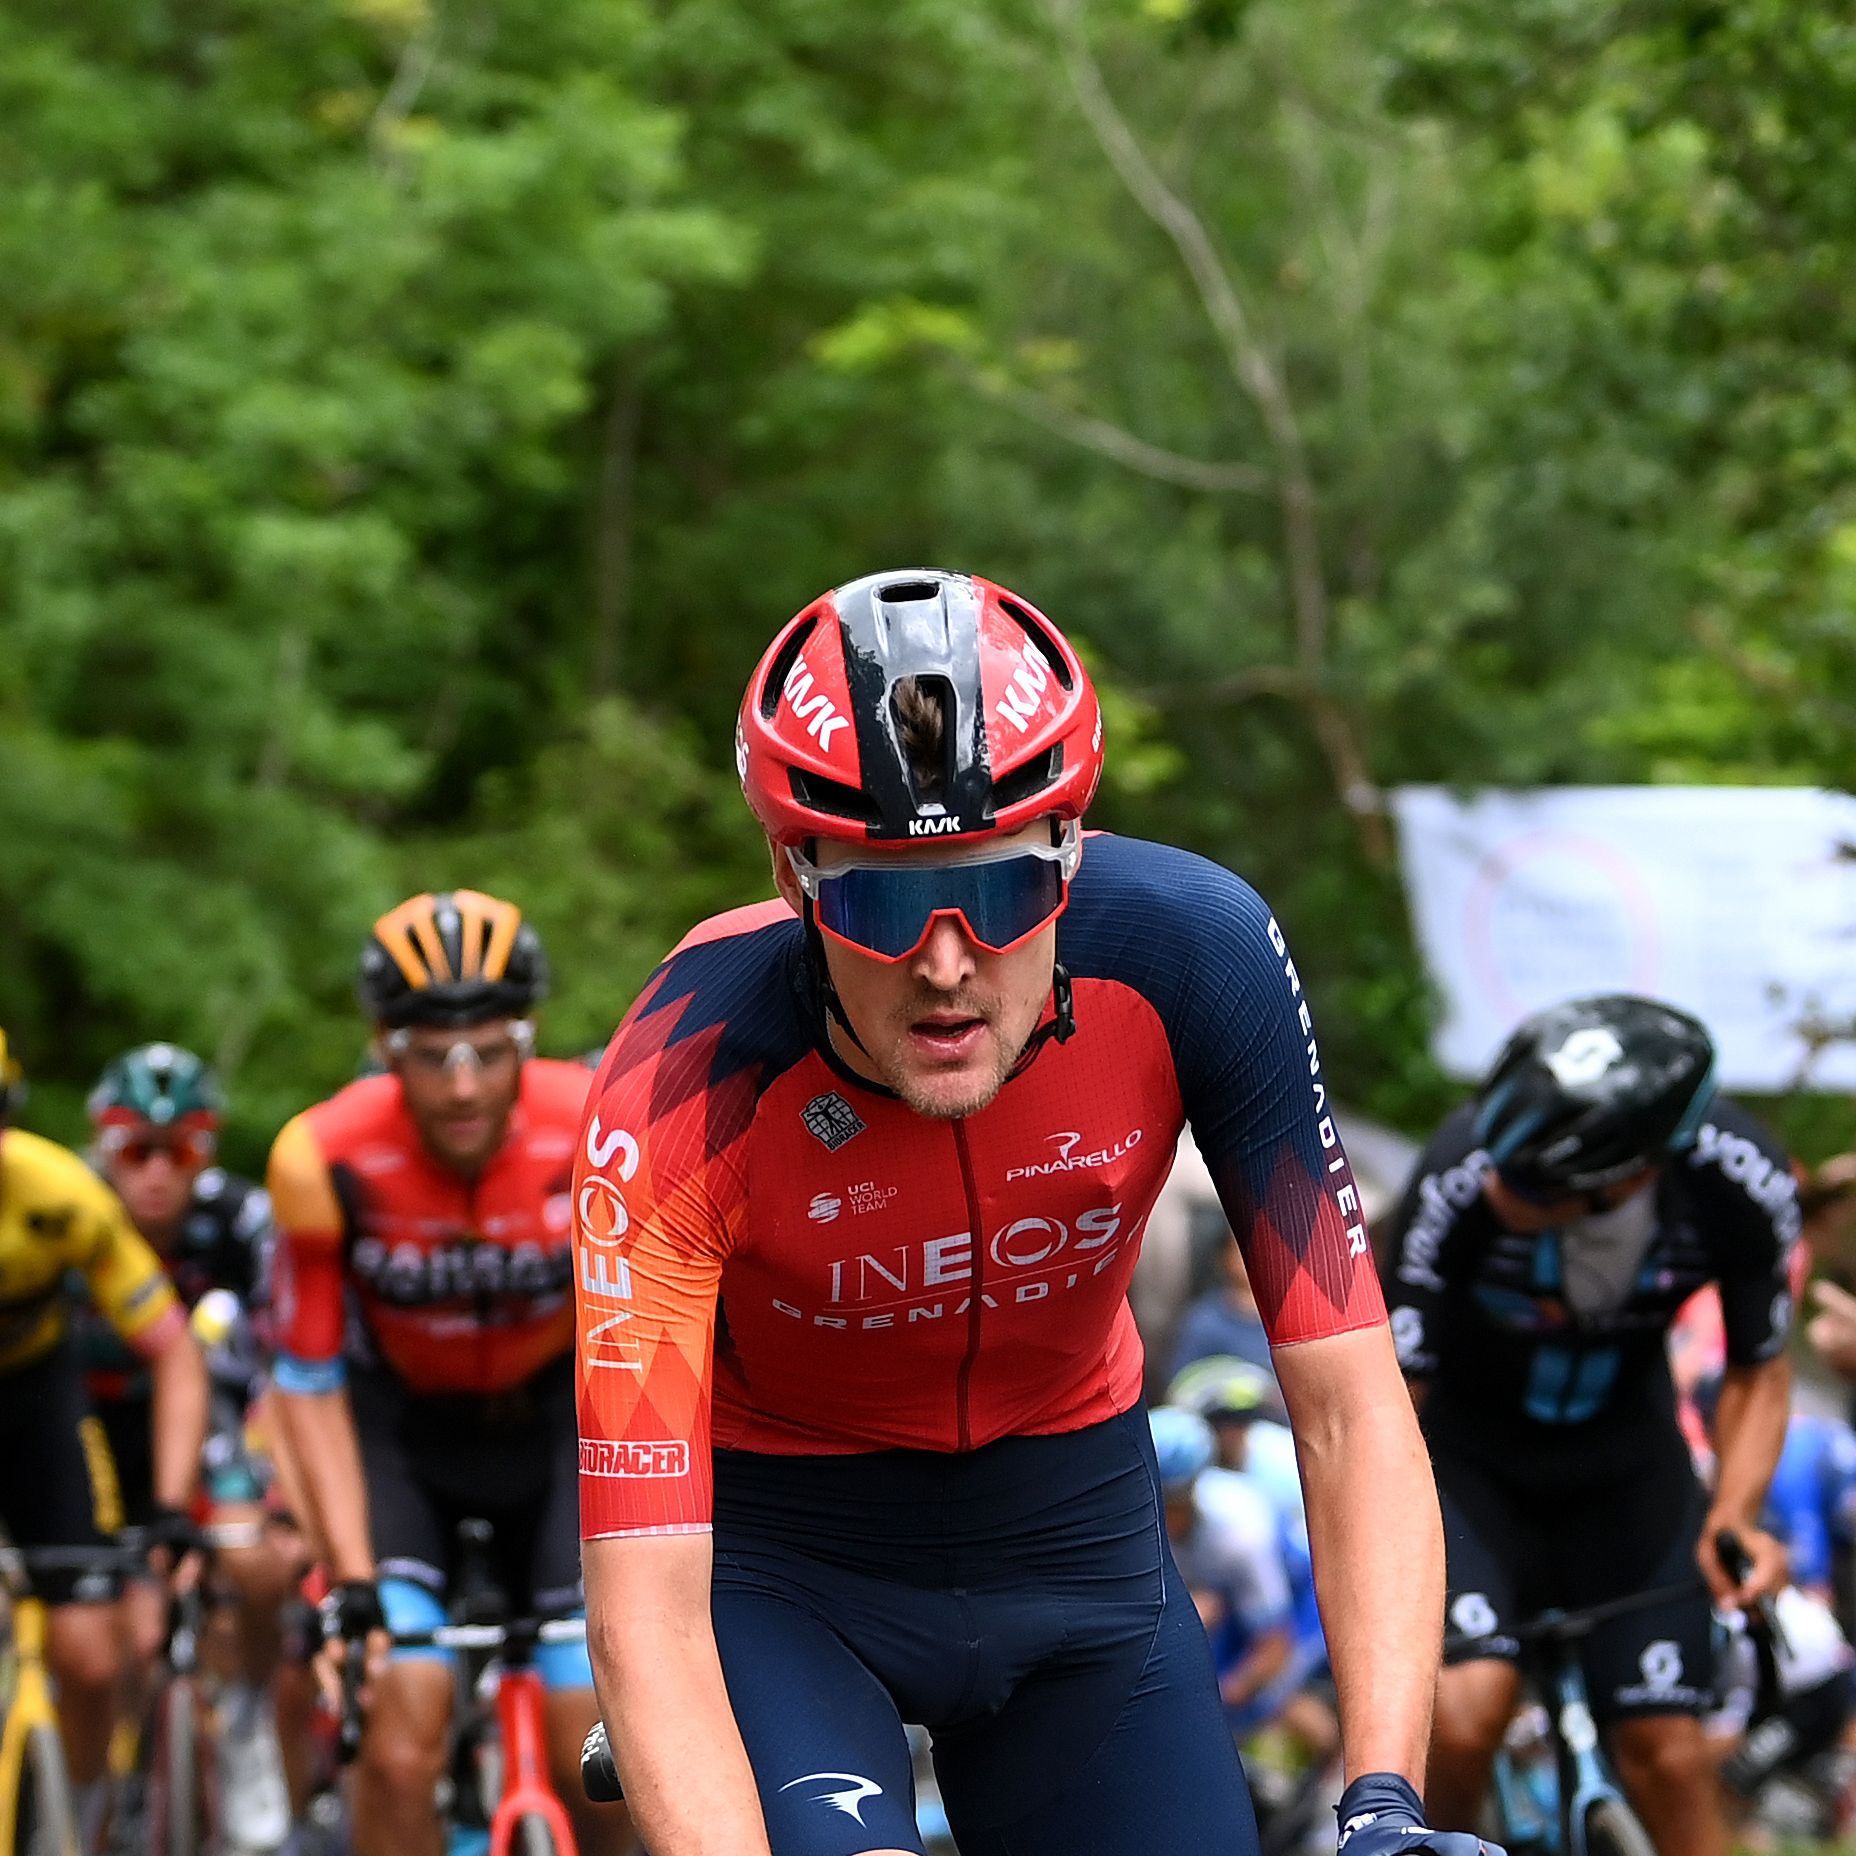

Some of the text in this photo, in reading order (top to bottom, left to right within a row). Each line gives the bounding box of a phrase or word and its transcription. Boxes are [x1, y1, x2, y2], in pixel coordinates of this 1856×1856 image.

[783, 654, 850, 752] KASK
[909, 815, 961, 835] KASK
[1267, 916, 1367, 1258] GRENADIER
[827, 1121, 865, 1151] BIORACER
[1006, 1129, 1142, 1182] PINARELLO
[848, 1181, 875, 1195] UCI
[849, 1186, 898, 1205] WORLD
[851, 1199, 887, 1215] TEAM
[578, 1115, 642, 1373] INEOS
[827, 1202, 1122, 1303] INEOS
[772, 1215, 1144, 1330] GRENADIE
